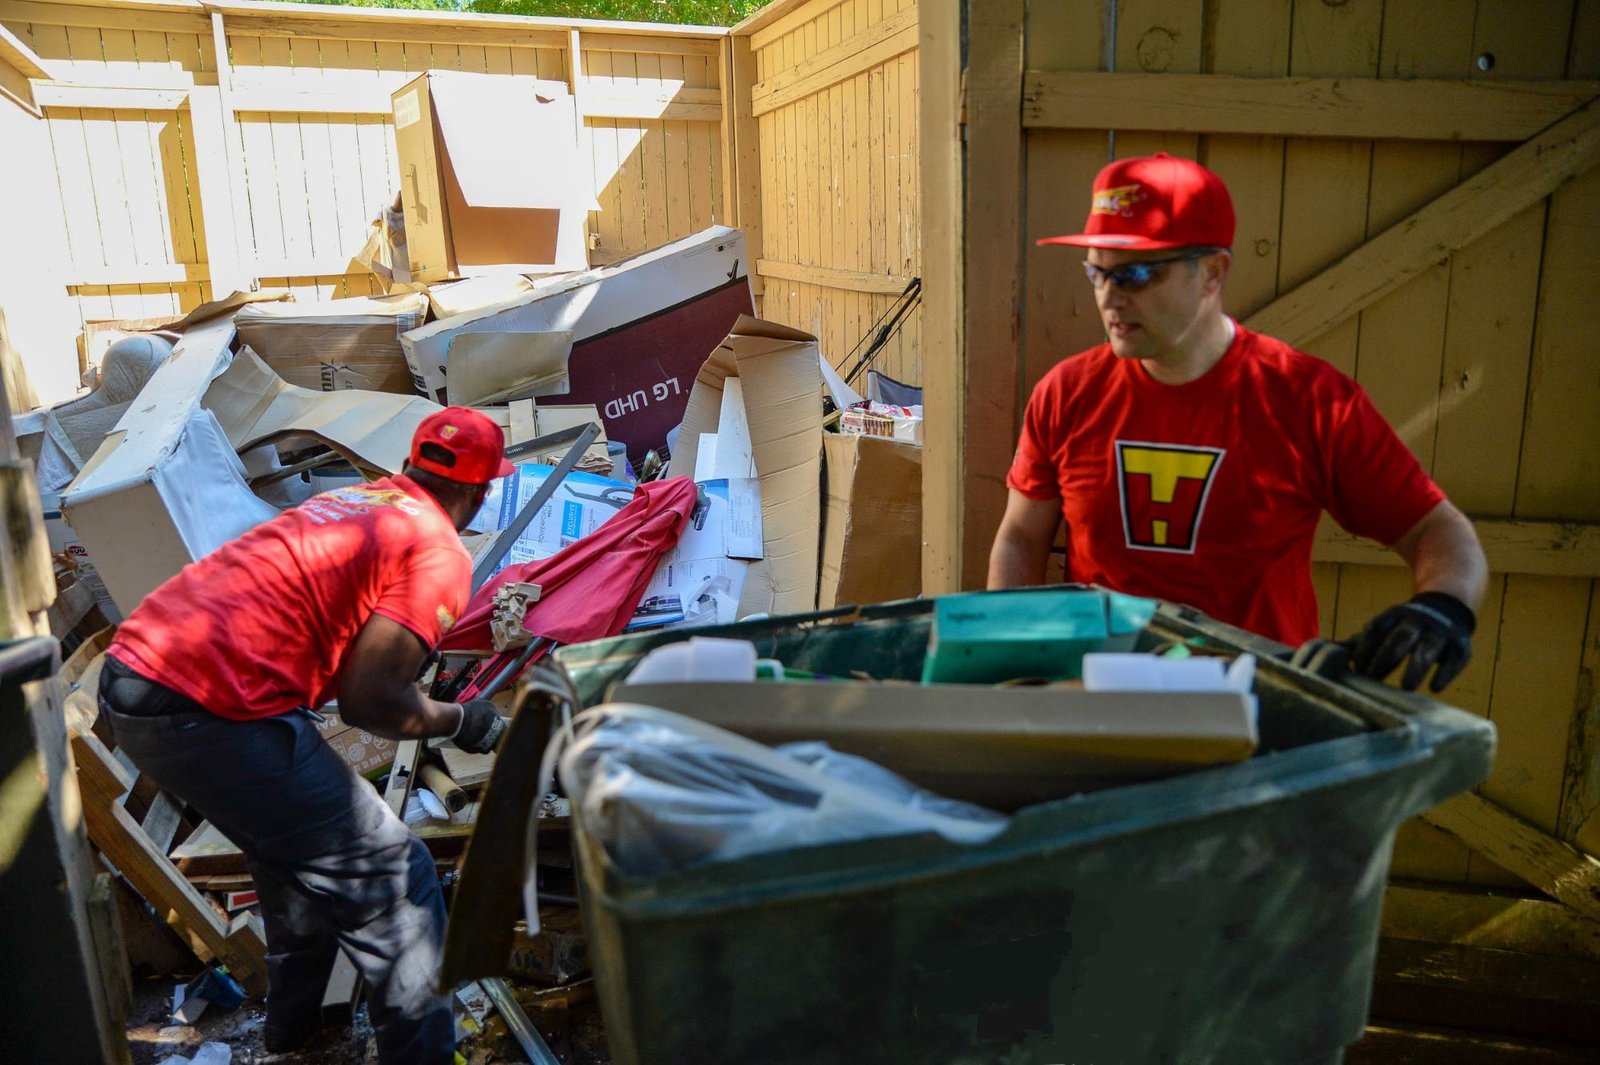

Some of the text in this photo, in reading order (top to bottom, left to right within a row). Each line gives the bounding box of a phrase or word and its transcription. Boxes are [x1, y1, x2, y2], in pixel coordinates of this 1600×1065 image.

[604, 377, 681, 419] LG UHD
[566, 503, 575, 534] EXCLUSIVE
